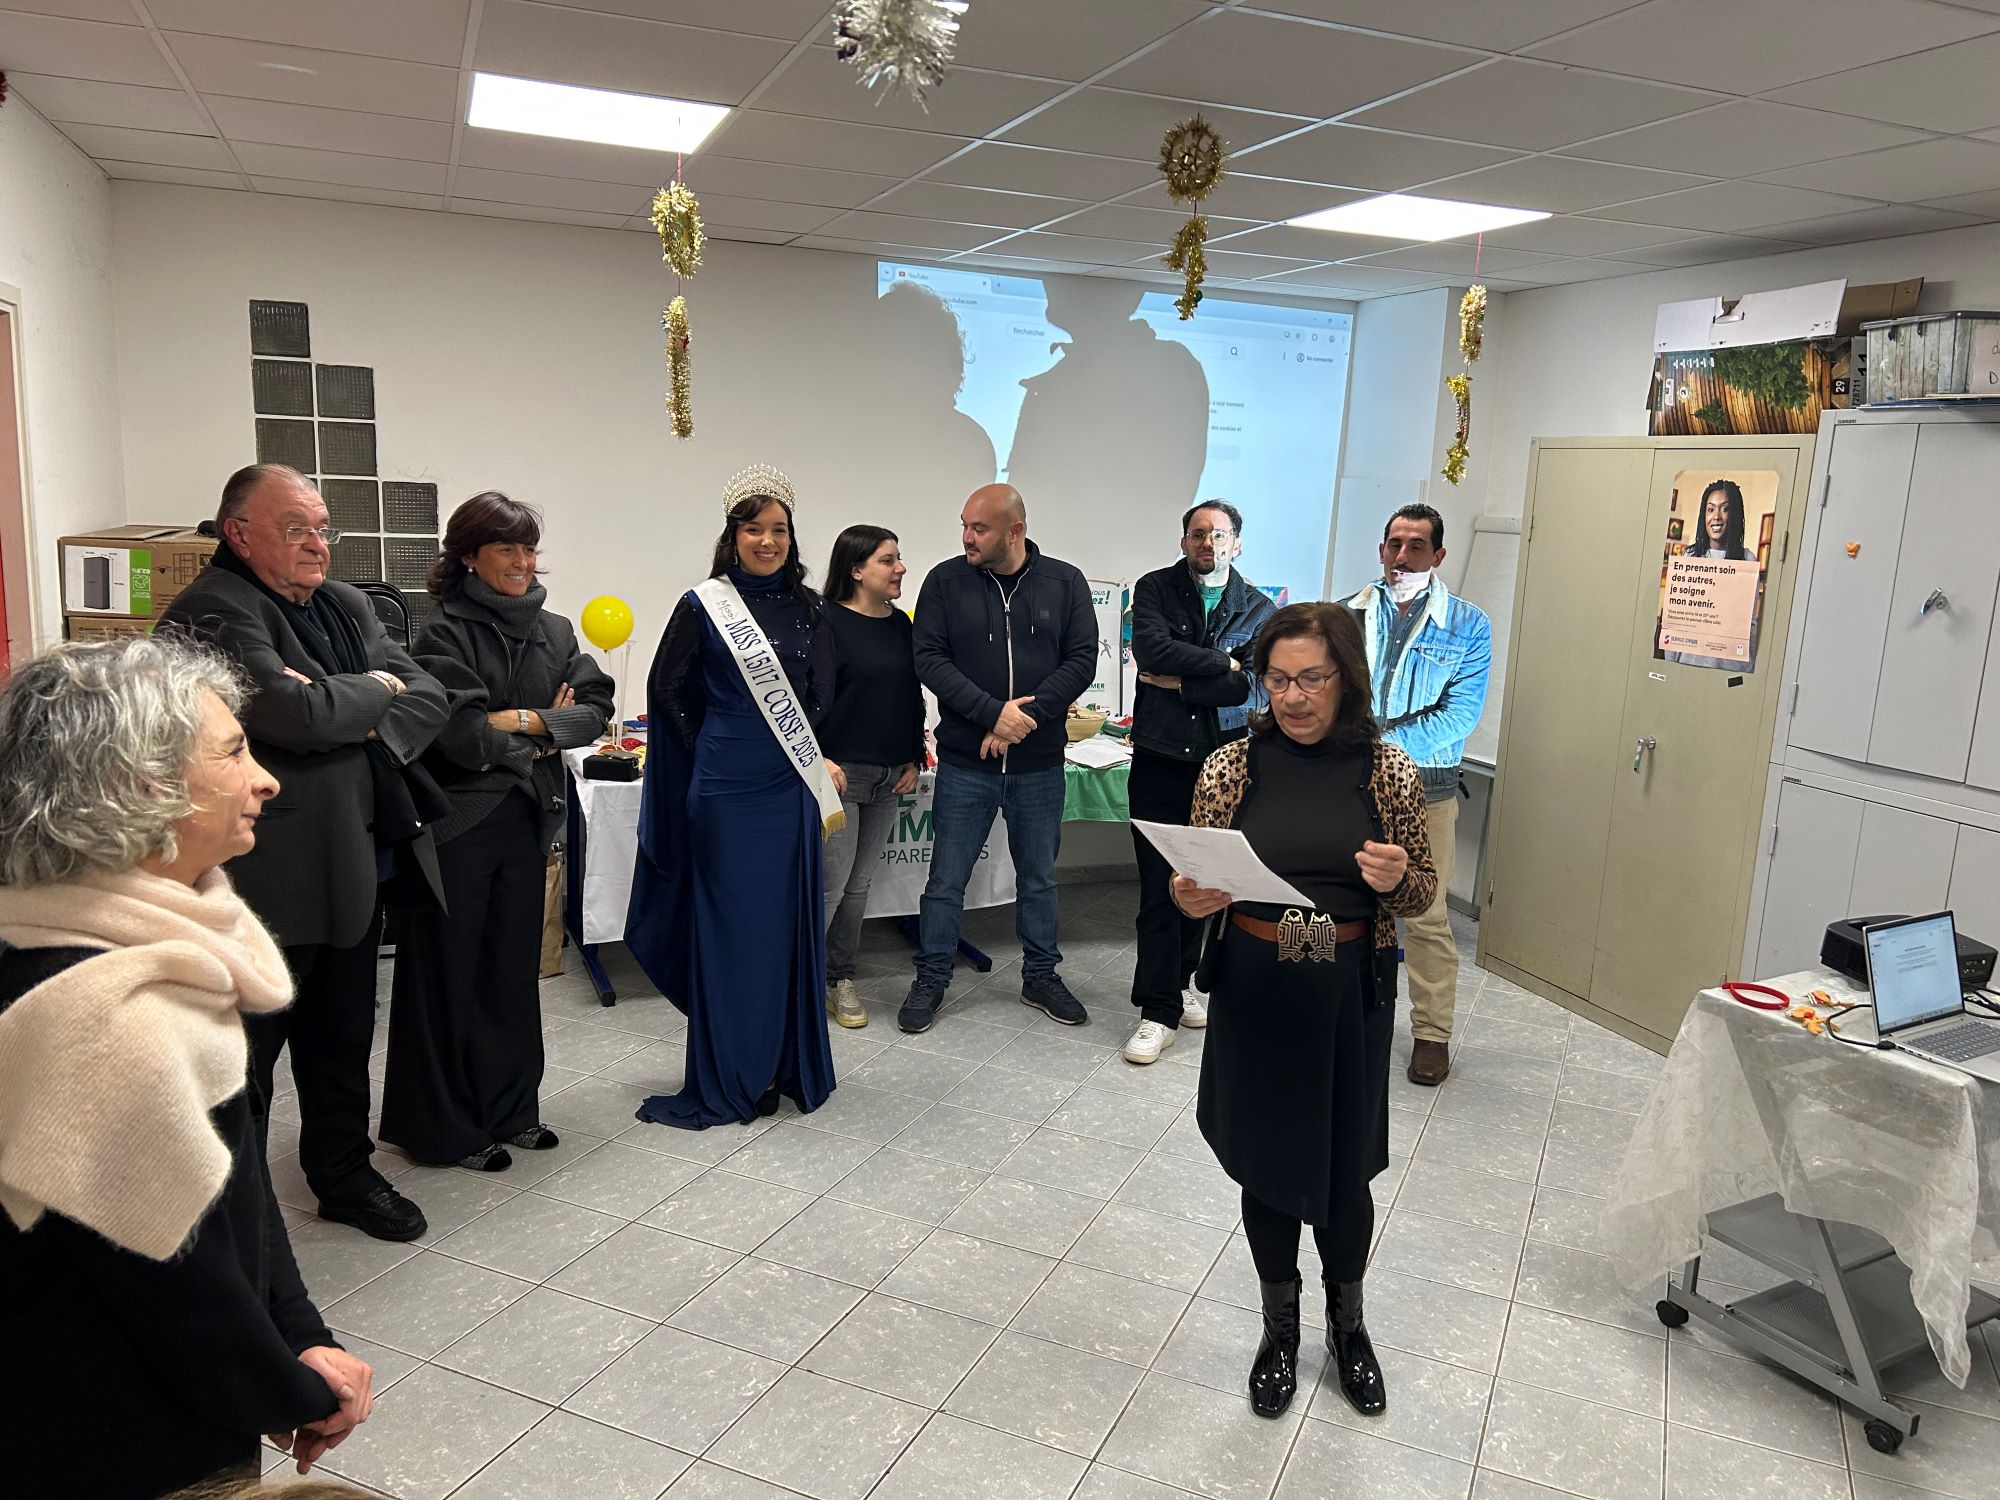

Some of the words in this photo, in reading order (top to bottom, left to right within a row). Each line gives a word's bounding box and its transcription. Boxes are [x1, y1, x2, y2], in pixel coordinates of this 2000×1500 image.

[1012, 327, 1045, 337] Rechercher
[1835, 380, 1845, 393] 29
[1674, 562, 1684, 570] En
[1685, 564, 1718, 573] prenant
[1719, 566, 1736, 574] soin
[1672, 573, 1685, 582] des
[1687, 575, 1716, 586] autres,
[1669, 584, 1678, 594] je
[1679, 586, 1705, 596] soigne
[1688, 599, 1715, 609] avenir.
[724, 618, 762, 651] MISS
[743, 649, 780, 686] 15/17
[763, 688, 806, 743] CORSE
[791, 735, 818, 768] 2025
